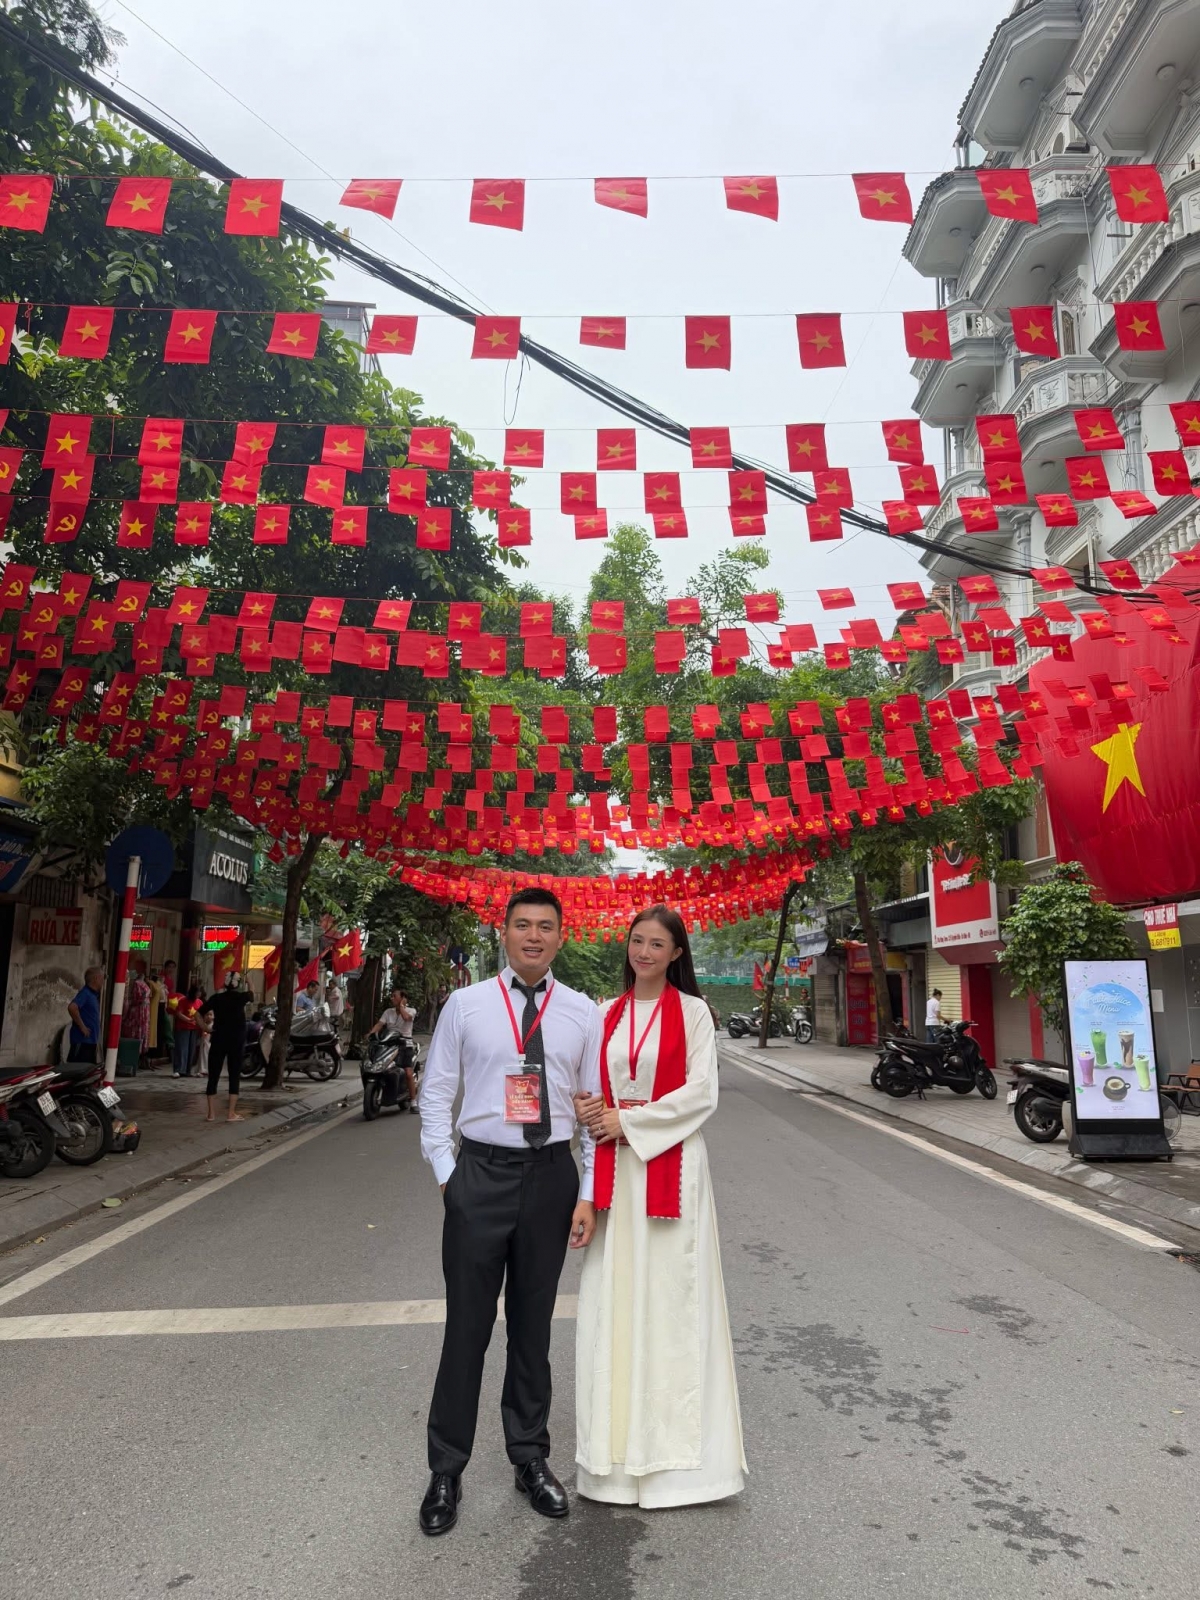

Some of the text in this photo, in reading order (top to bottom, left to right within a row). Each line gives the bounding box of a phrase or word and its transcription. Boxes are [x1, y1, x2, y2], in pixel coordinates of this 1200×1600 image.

[62, 920, 80, 944] XE
[1107, 993, 1131, 1006] Juice
[1098, 1003, 1121, 1012] Menu
